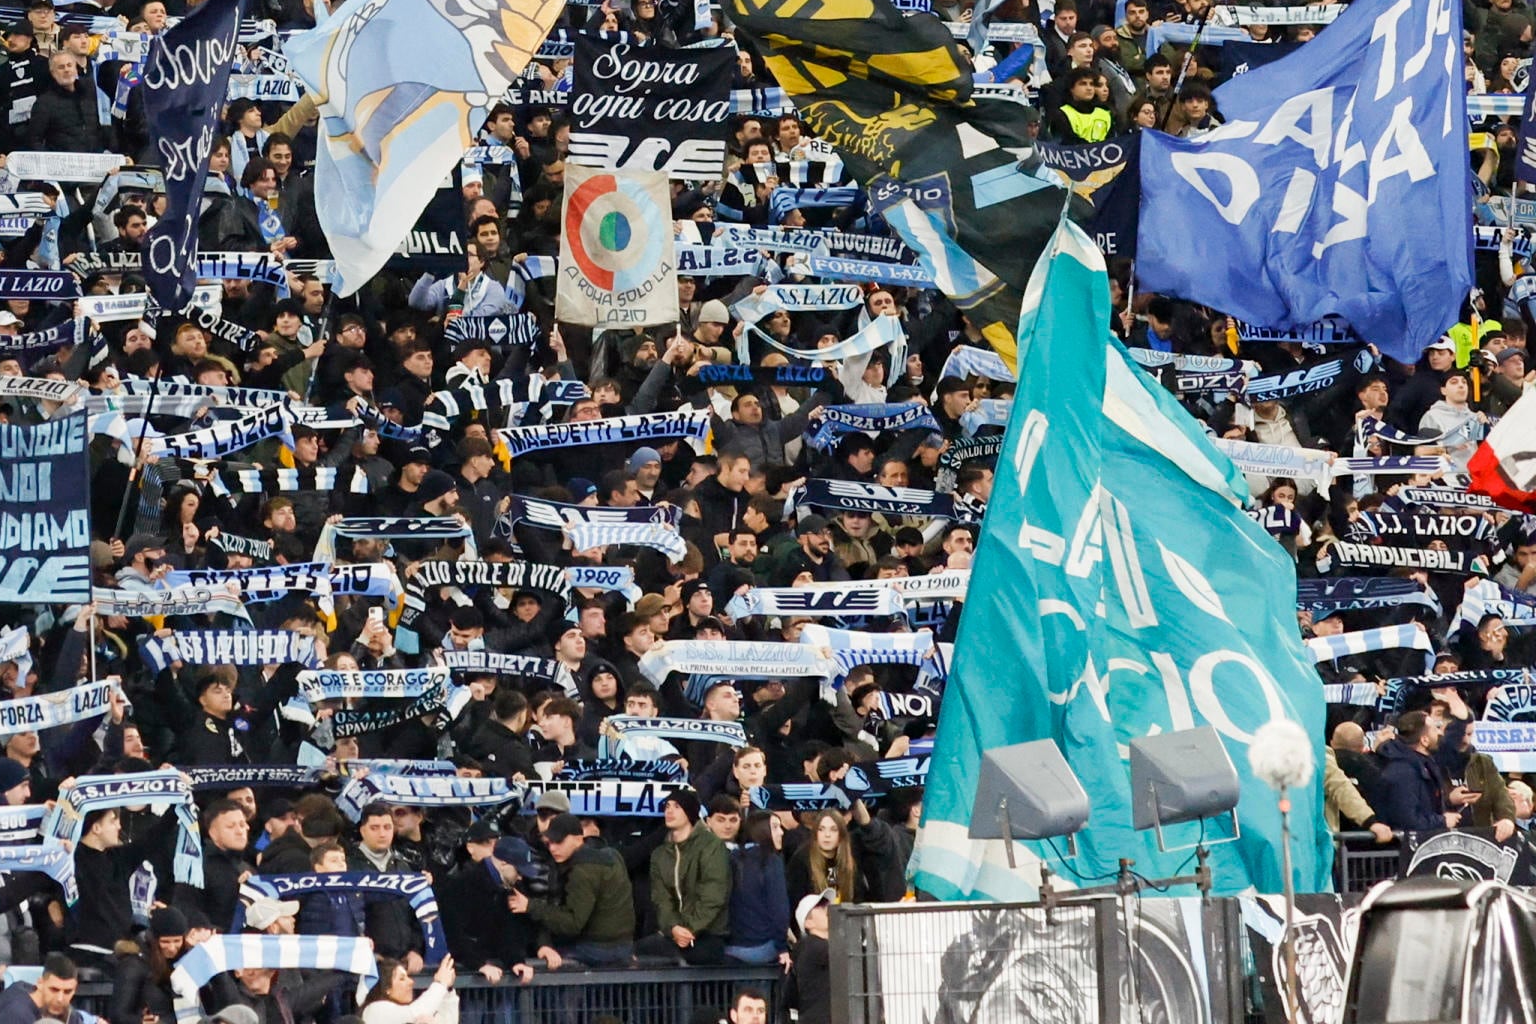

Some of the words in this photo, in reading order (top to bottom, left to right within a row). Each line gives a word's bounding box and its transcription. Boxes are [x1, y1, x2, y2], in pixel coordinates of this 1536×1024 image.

[592, 43, 699, 94] Sopra
[257, 78, 290, 96] LAZIO
[572, 91, 644, 130] ogni
[653, 97, 730, 125] cosa
[772, 229, 822, 250] LAZIO
[815, 259, 879, 278] FORZA
[11, 275, 64, 293] LAZIO
[617, 281, 651, 304] SOLO
[649, 262, 673, 288] LA
[776, 286, 861, 307] S.S.LAZIO
[596, 308, 646, 324] LAZIO
[699, 367, 752, 383] FORZA
[775, 367, 825, 382] LAZIO
[6, 378, 68, 395] LAZIO
[1414, 514, 1477, 536] LAZIO
[1334, 540, 1465, 571] IRRIDUCIBILI
[455, 560, 506, 586] STILE
[574, 568, 622, 586] 1900
[925, 576, 961, 590] 1900
[112, 603, 170, 617] PATRIA
[173, 600, 207, 615] NOSTRA
[302, 672, 354, 691] AMORE
[355, 673, 363, 686] E
[368, 669, 445, 687] CORAGGIO
[0, 701, 45, 728] FORZA
[74, 684, 112, 714] LAZIO
[895, 691, 934, 717] NOI
